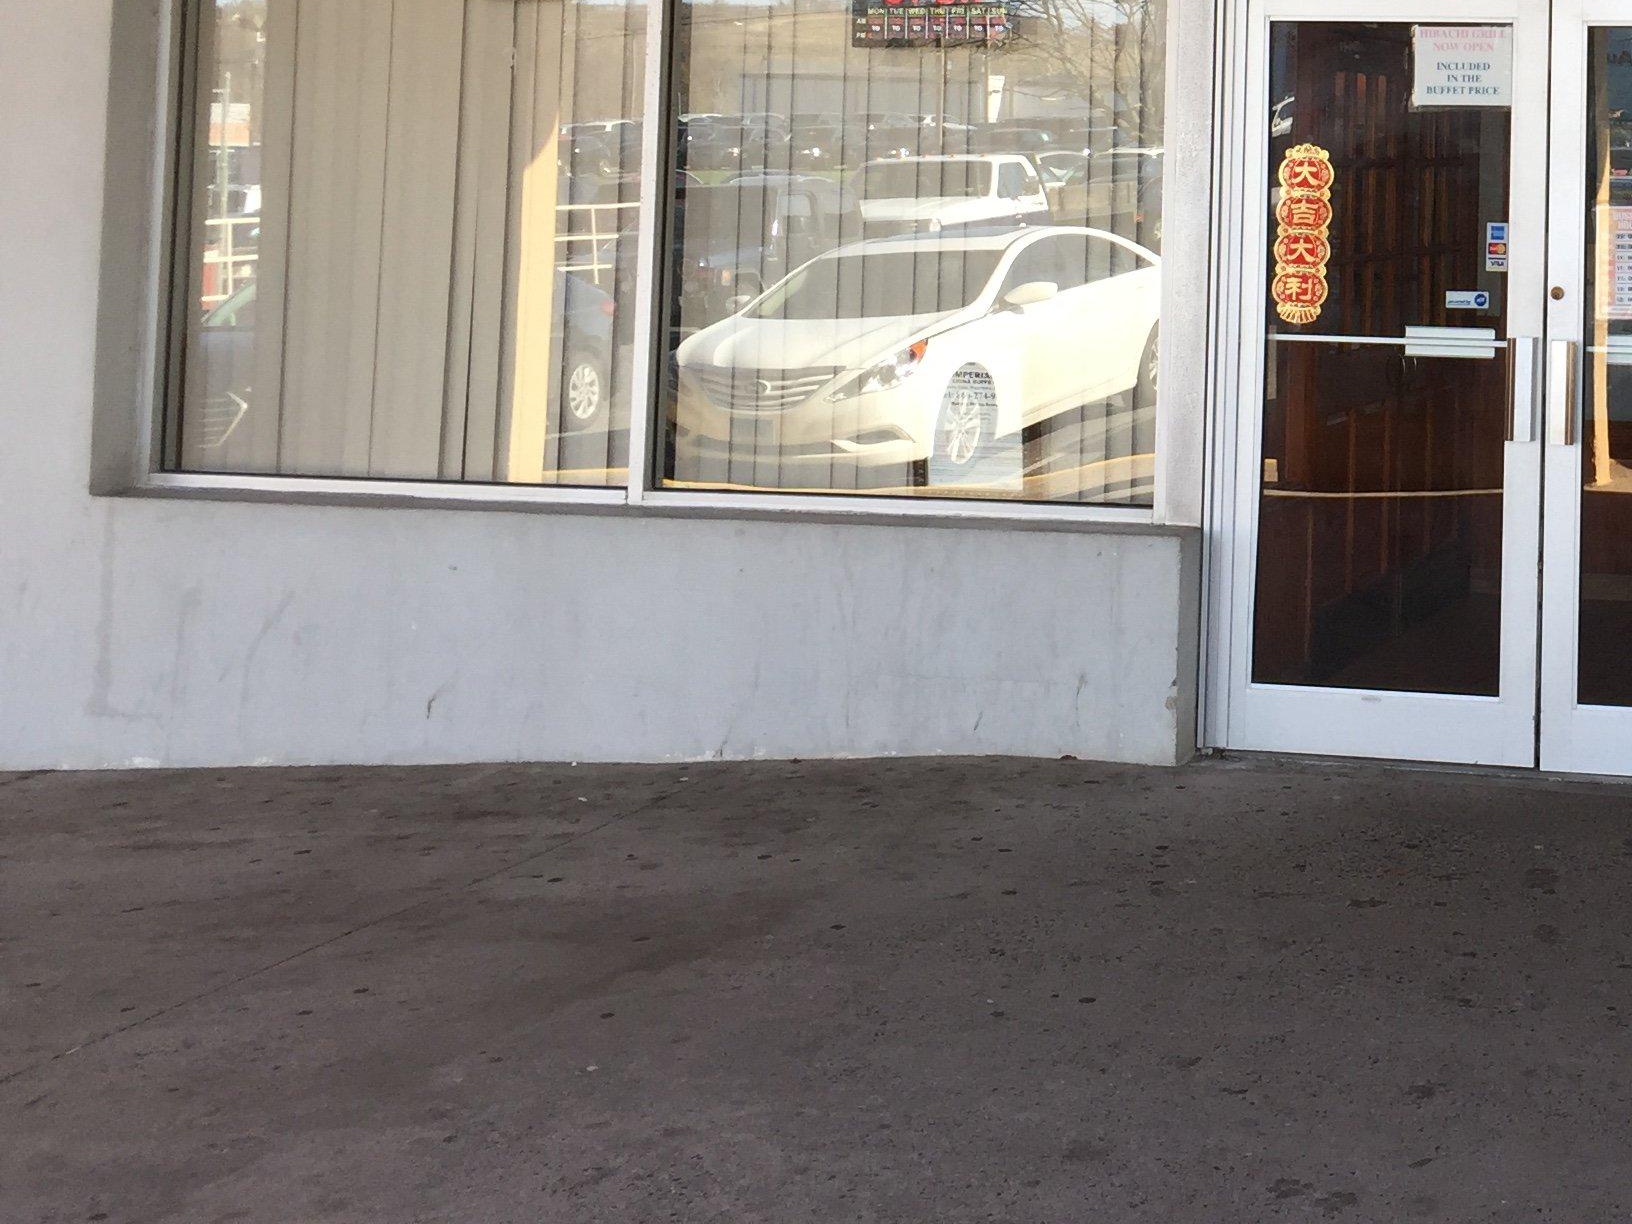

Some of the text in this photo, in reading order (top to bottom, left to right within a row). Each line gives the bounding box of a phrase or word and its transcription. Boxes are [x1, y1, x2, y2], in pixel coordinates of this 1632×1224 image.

[867, 7, 885, 16] MON
[890, 7, 904, 16] TUE
[908, 7, 926, 16] WED
[930, 7, 946, 16] THU
[971, 7, 987, 16] SAT
[1433, 42, 1495, 52] NOW OPEN
[1436, 62, 1491, 71] INCLUDED
[1447, 74, 1482, 82] IN THE
[1426, 86, 1500, 95] BUFFET PRICE
[1284, 160, 1321, 303] 大吉大利
